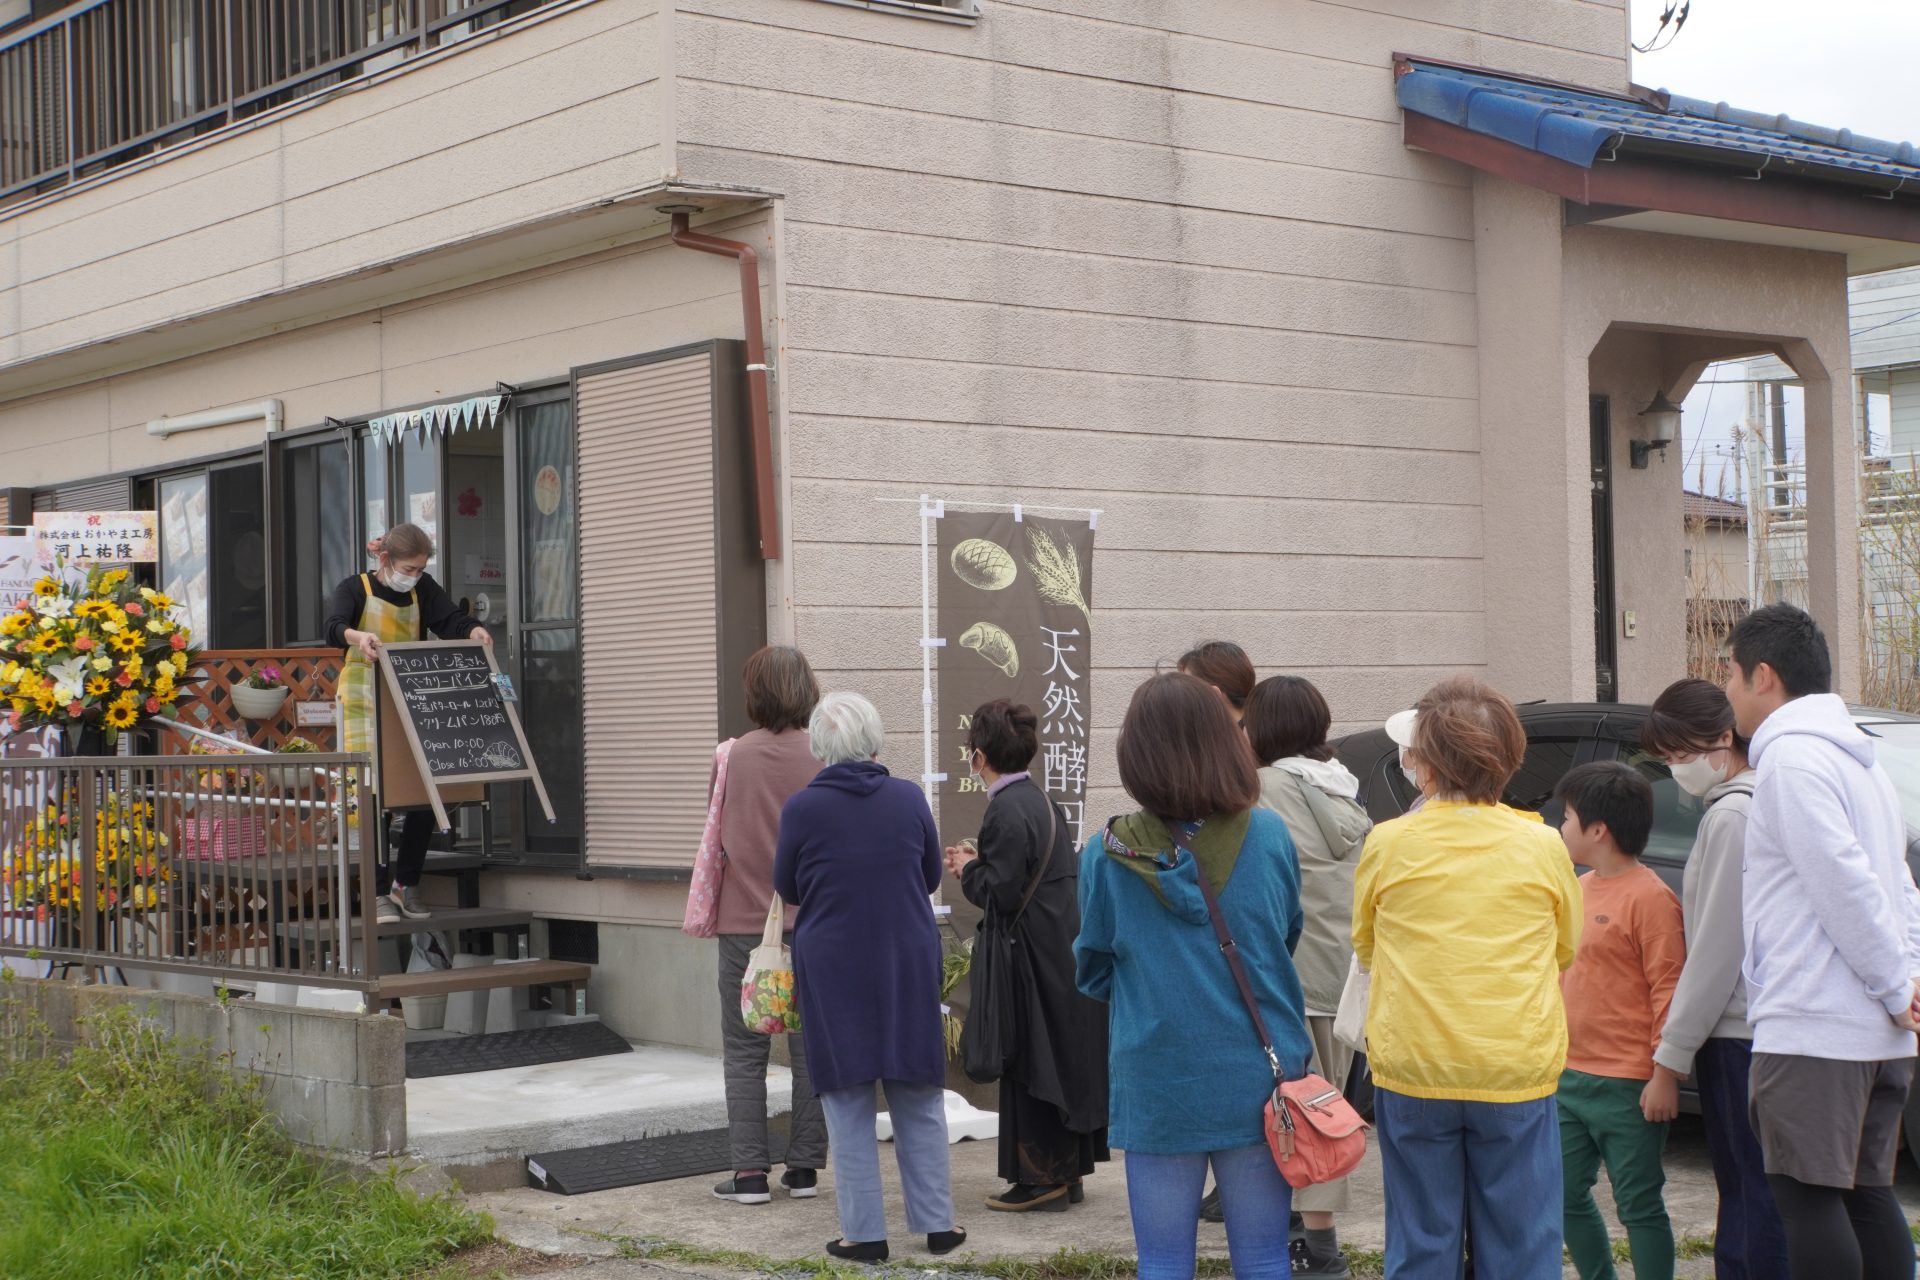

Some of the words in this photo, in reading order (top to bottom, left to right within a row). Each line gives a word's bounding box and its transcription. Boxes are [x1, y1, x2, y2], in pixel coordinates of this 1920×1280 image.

[87, 514, 101, 526] 祝
[39, 529, 81, 539] 株式会社
[85, 528, 153, 540] おかやま工房
[55, 543, 133, 559] 河上祐隆
[390, 654, 486, 672] 町のパン屋さん
[406, 672, 489, 689] ベーカリーパイン
[423, 739, 451, 752] Open
[454, 738, 484, 749] 10:00
[428, 757, 456, 771] Close
